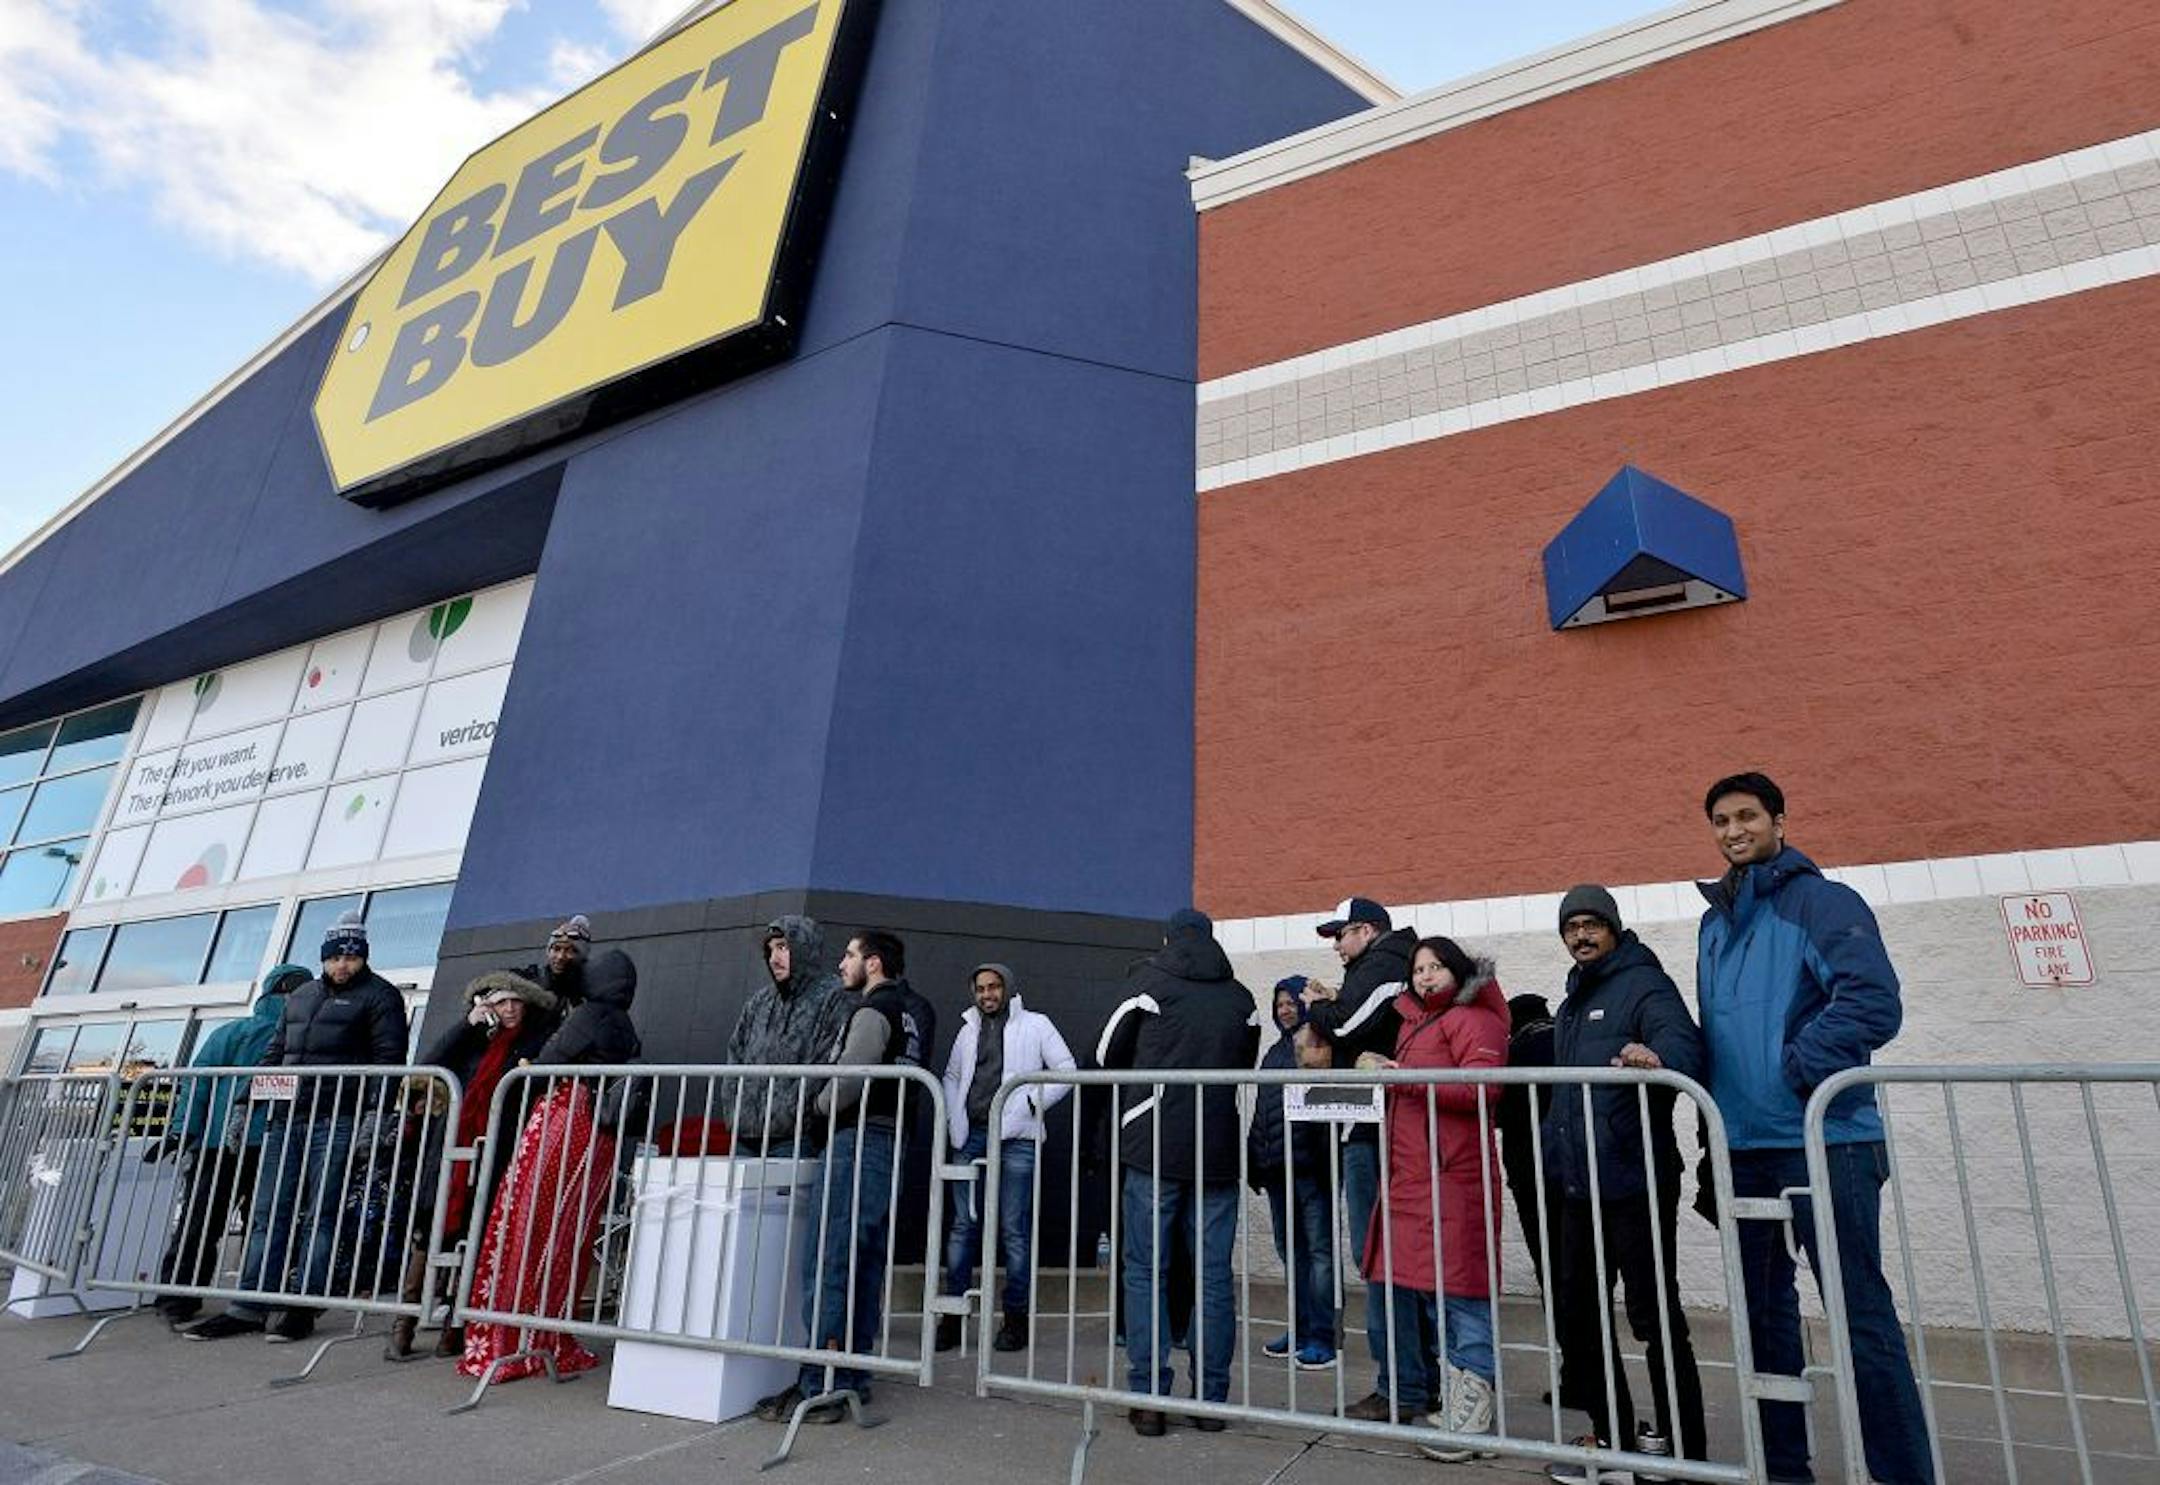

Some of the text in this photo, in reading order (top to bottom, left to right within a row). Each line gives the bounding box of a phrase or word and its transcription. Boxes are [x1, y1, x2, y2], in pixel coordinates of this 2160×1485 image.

[396, 4, 820, 310] BEST
[364, 151, 744, 424] BUY
[440, 719, 496, 747] verizo
[138, 766, 163, 786] The
[189, 755, 217, 779] you
[217, 742, 257, 767] want.
[128, 793, 153, 814] The
[152, 778, 213, 806] network
[210, 775, 241, 801] you
[2024, 902, 2053, 920] NO
[2012, 921, 2078, 942] PARKING
[2035, 945, 2066, 959] FIRE
[2037, 961, 2073, 977] LANE
